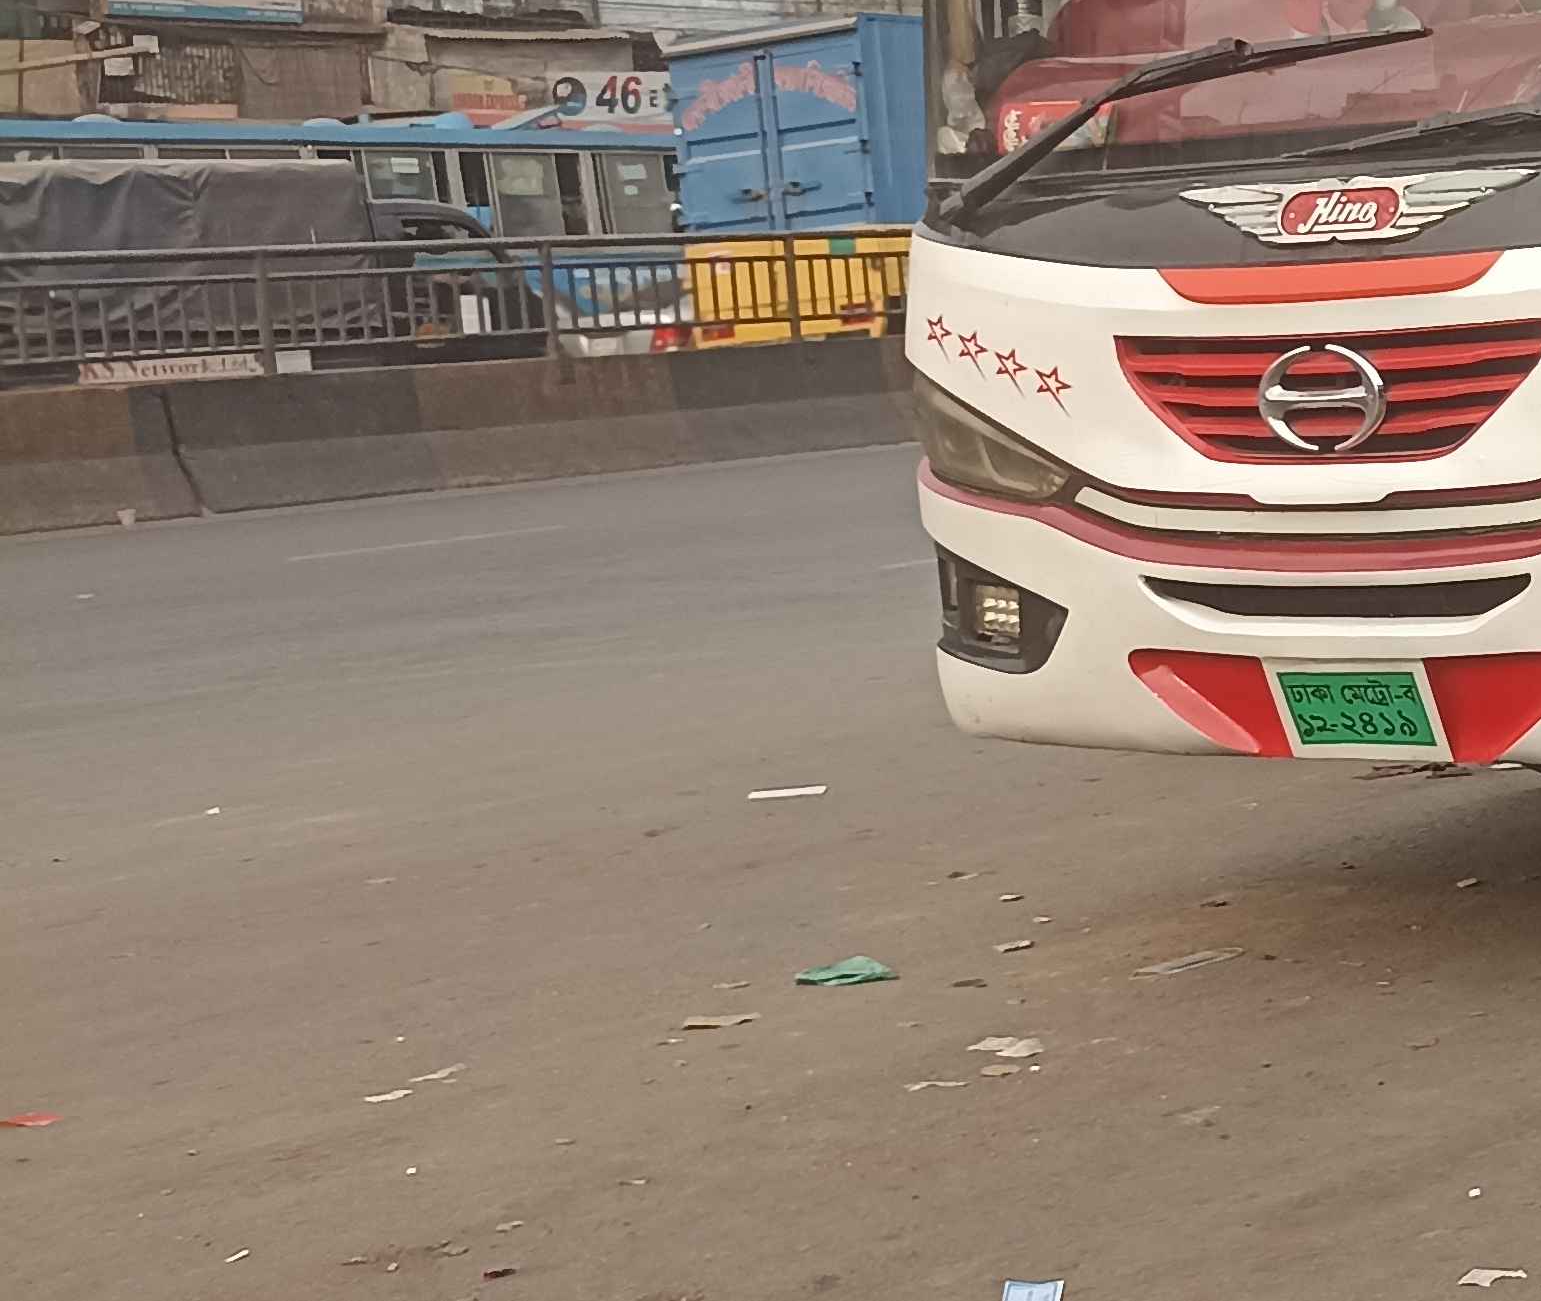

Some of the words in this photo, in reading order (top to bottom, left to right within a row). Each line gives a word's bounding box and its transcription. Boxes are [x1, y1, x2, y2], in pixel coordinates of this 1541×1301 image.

[595, 75, 643, 114] 46
[1298, 193, 1377, 233] Hino
[1286, 684, 1335, 705] ঢাকা
[1297, 710, 1418, 738] ১২-২৪১৯
